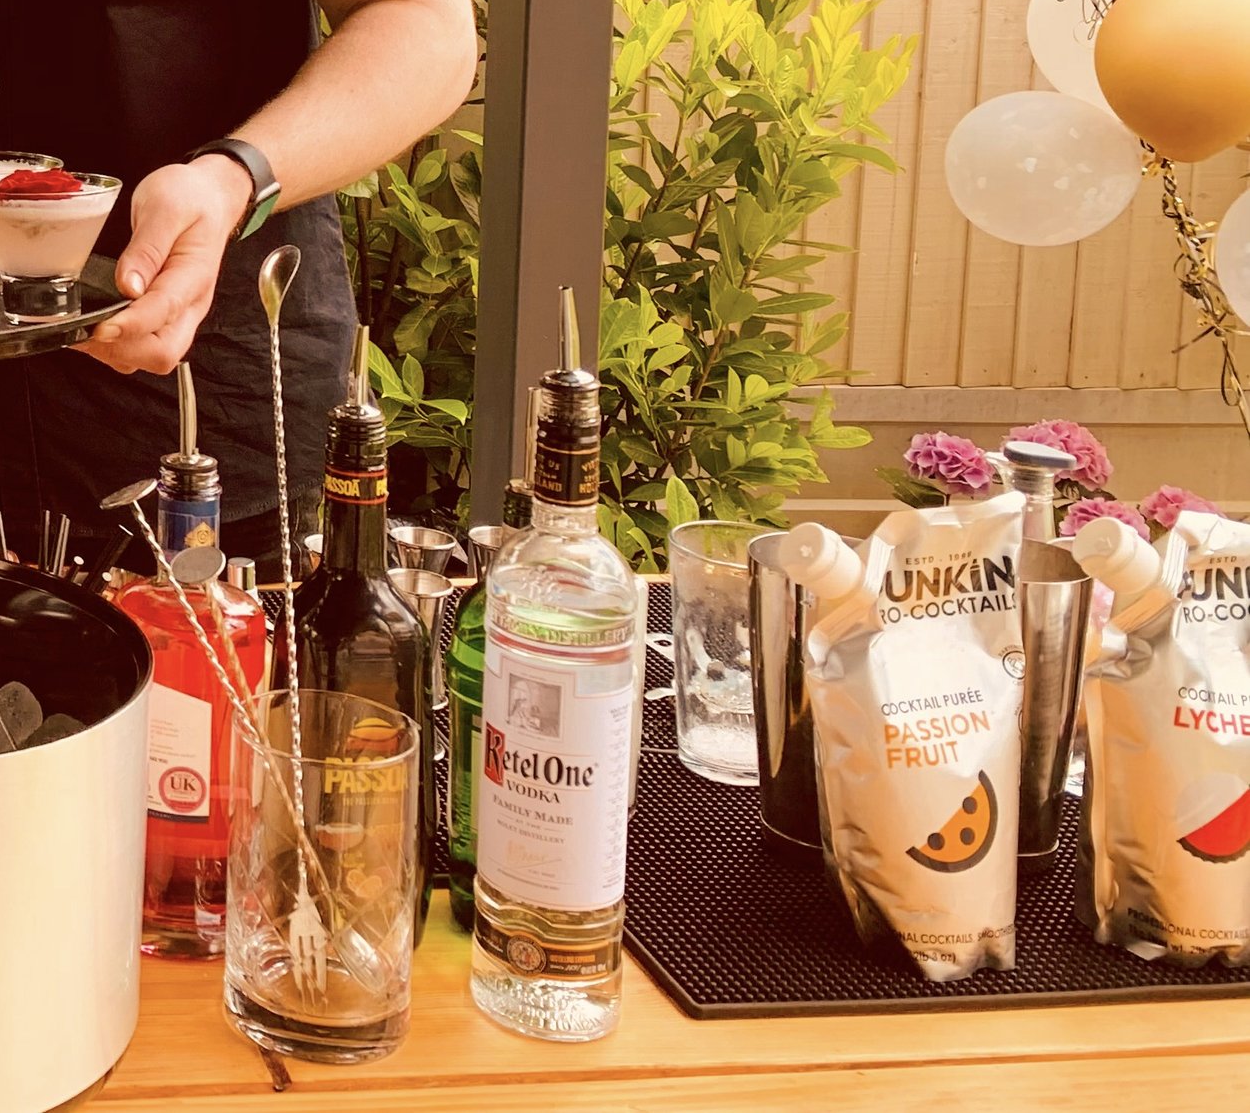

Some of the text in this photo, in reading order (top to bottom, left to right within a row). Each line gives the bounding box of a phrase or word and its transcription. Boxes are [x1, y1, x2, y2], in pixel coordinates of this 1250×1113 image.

[881, 687, 984, 717] COCKTAIL PURÉE
[1177, 686, 1250, 707] COCKTAIL P
[883, 710, 991, 744] PASSION
[485, 727, 595, 787] Ketel One
[886, 740, 959, 769] FRUIT
[170, 776, 197, 792] UK
[505, 779, 562, 805] VODKA
[492, 793, 575, 827] FAMILY MADE
